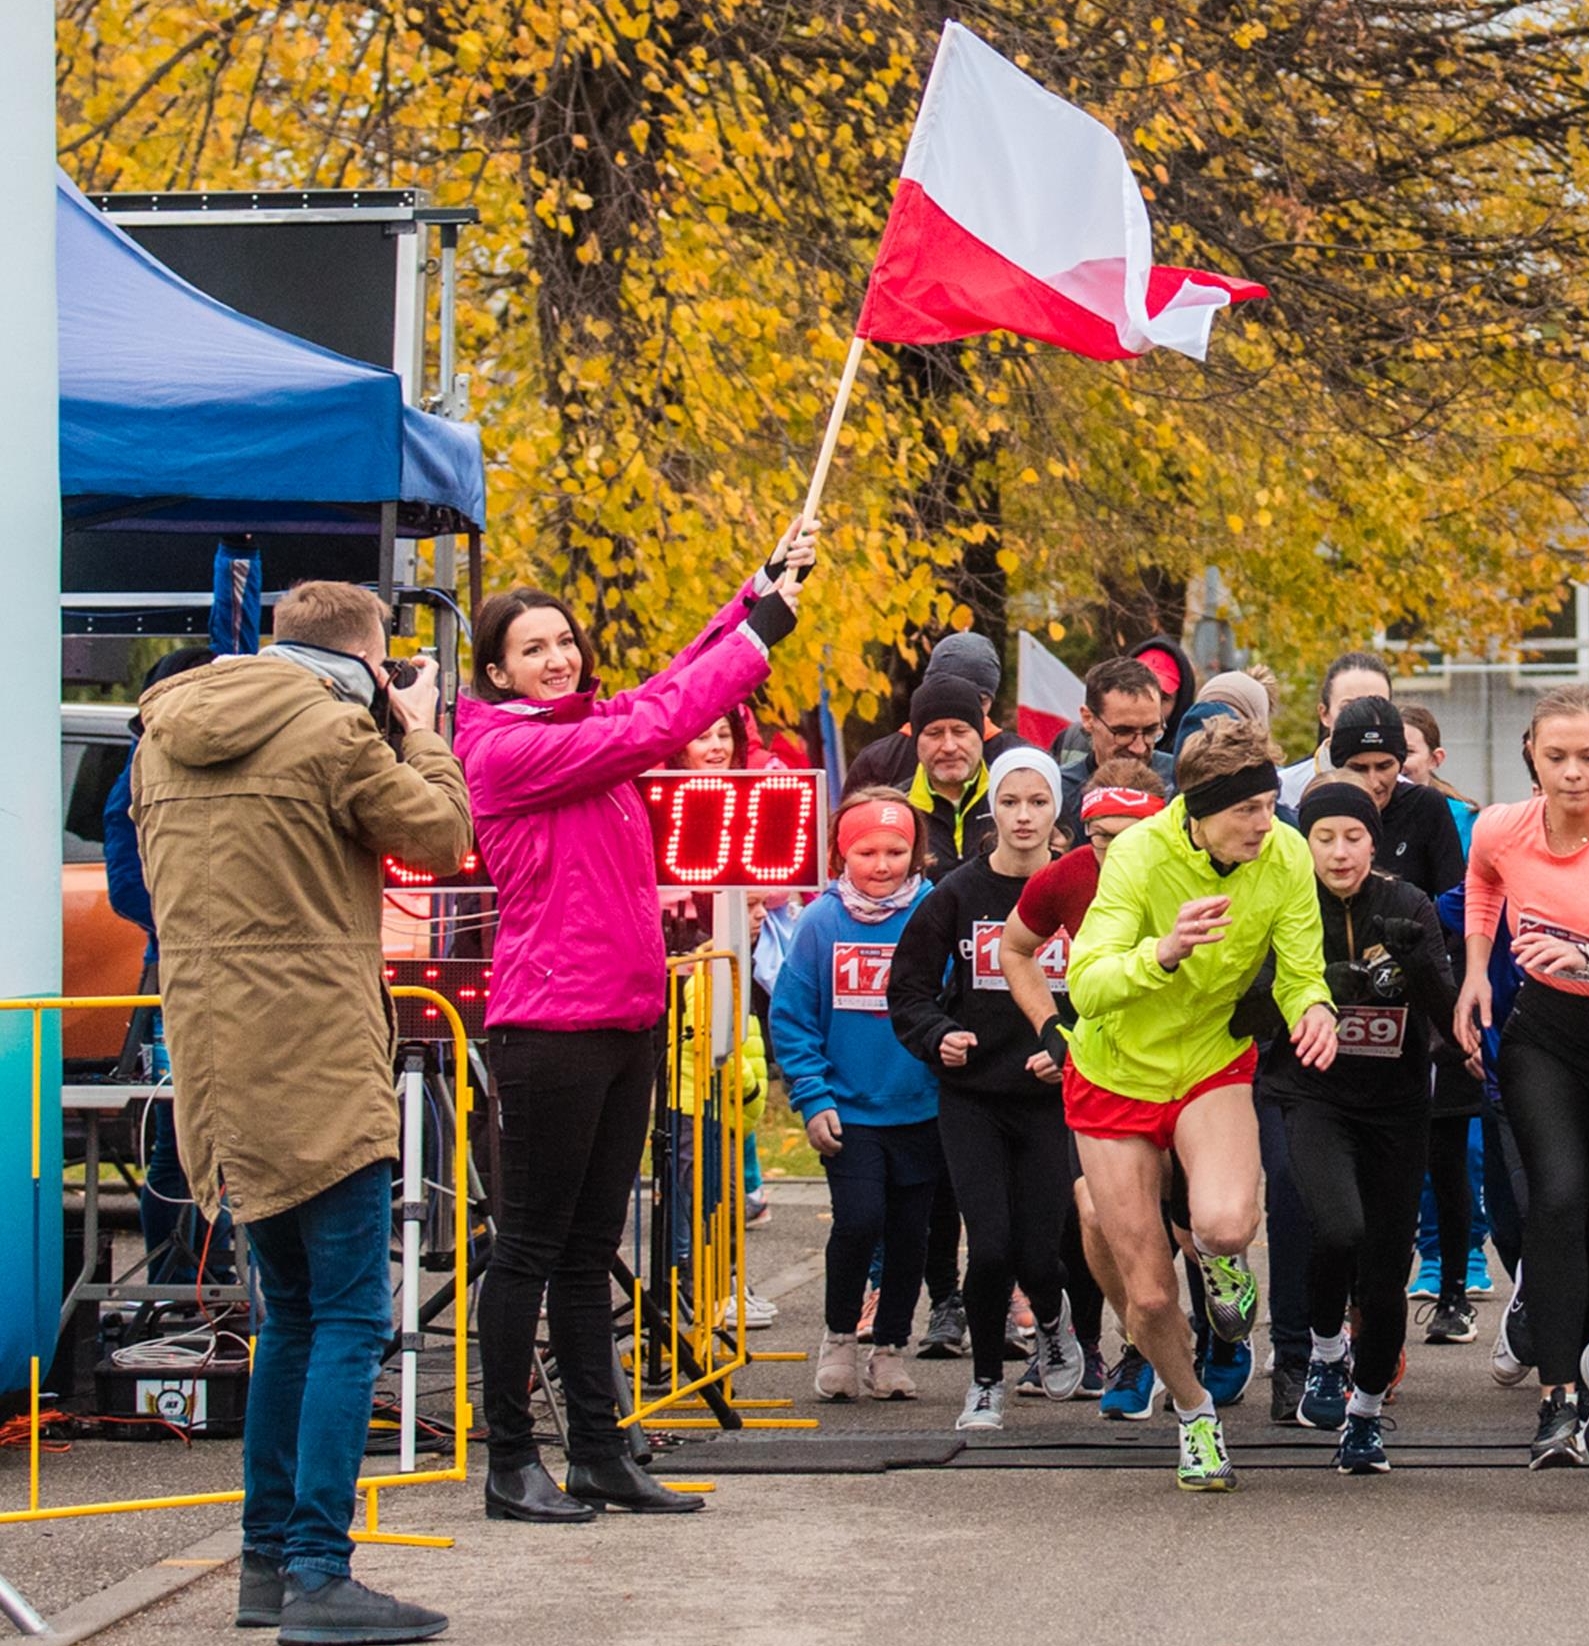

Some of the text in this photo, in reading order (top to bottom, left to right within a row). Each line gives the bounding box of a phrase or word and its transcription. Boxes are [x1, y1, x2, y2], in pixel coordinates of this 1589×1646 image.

[981, 937, 1067, 973] 14
[840, 957, 892, 990] 17
[1338, 1016, 1398, 1043] 69
